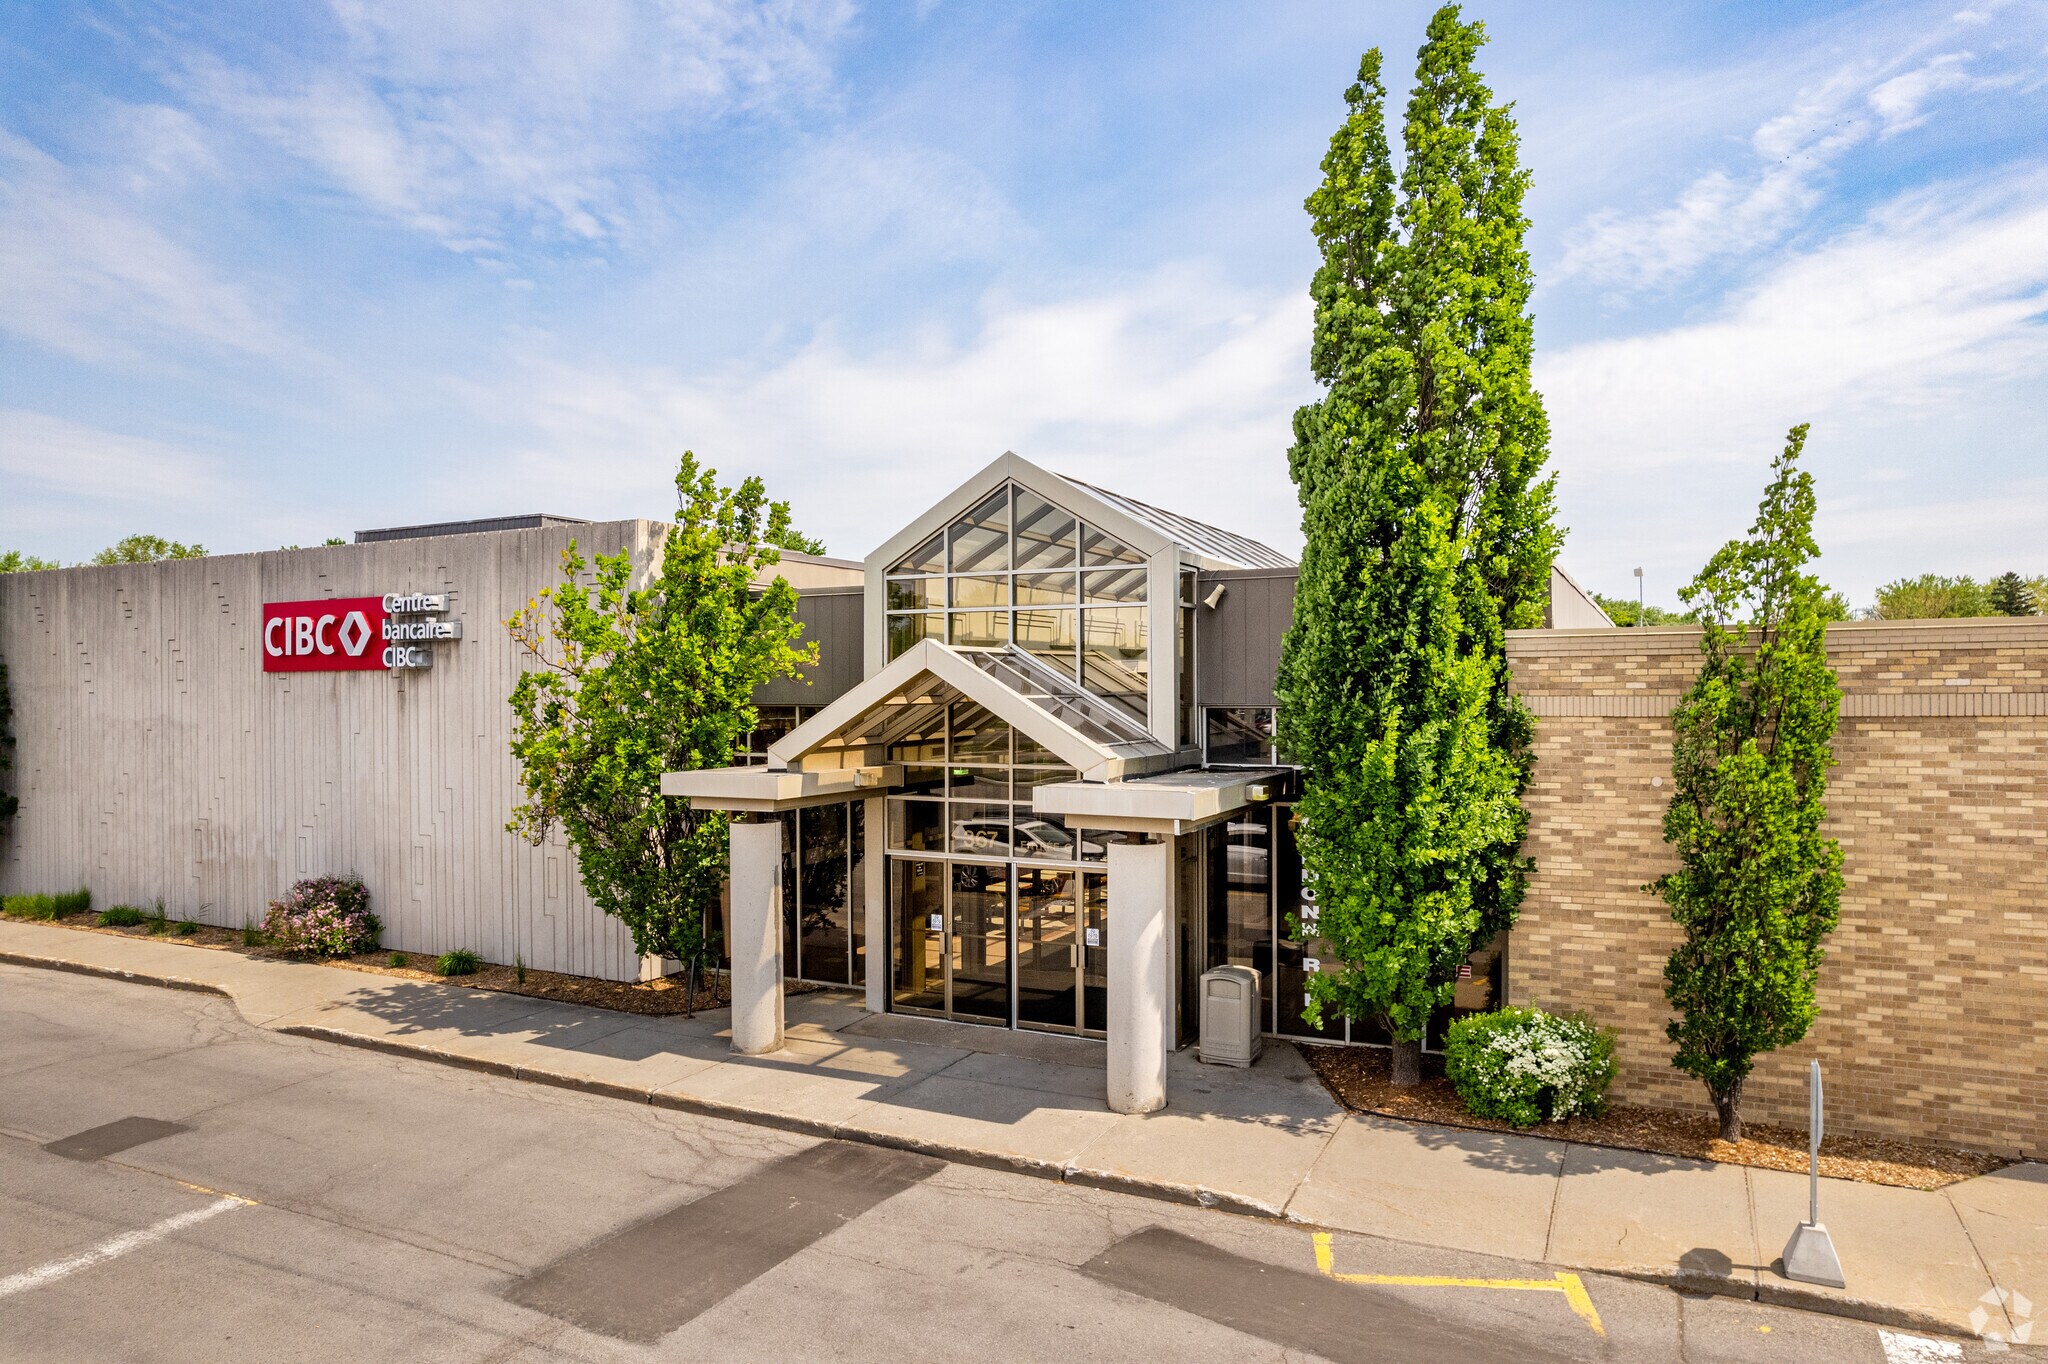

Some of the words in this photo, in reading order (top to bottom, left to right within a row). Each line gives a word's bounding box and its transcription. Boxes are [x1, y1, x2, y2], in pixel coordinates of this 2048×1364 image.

[382, 592, 432, 613] Centre
[264, 614, 336, 657] CIBC
[382, 616, 444, 640] bancaire
[382, 646, 416, 667] CIBC
